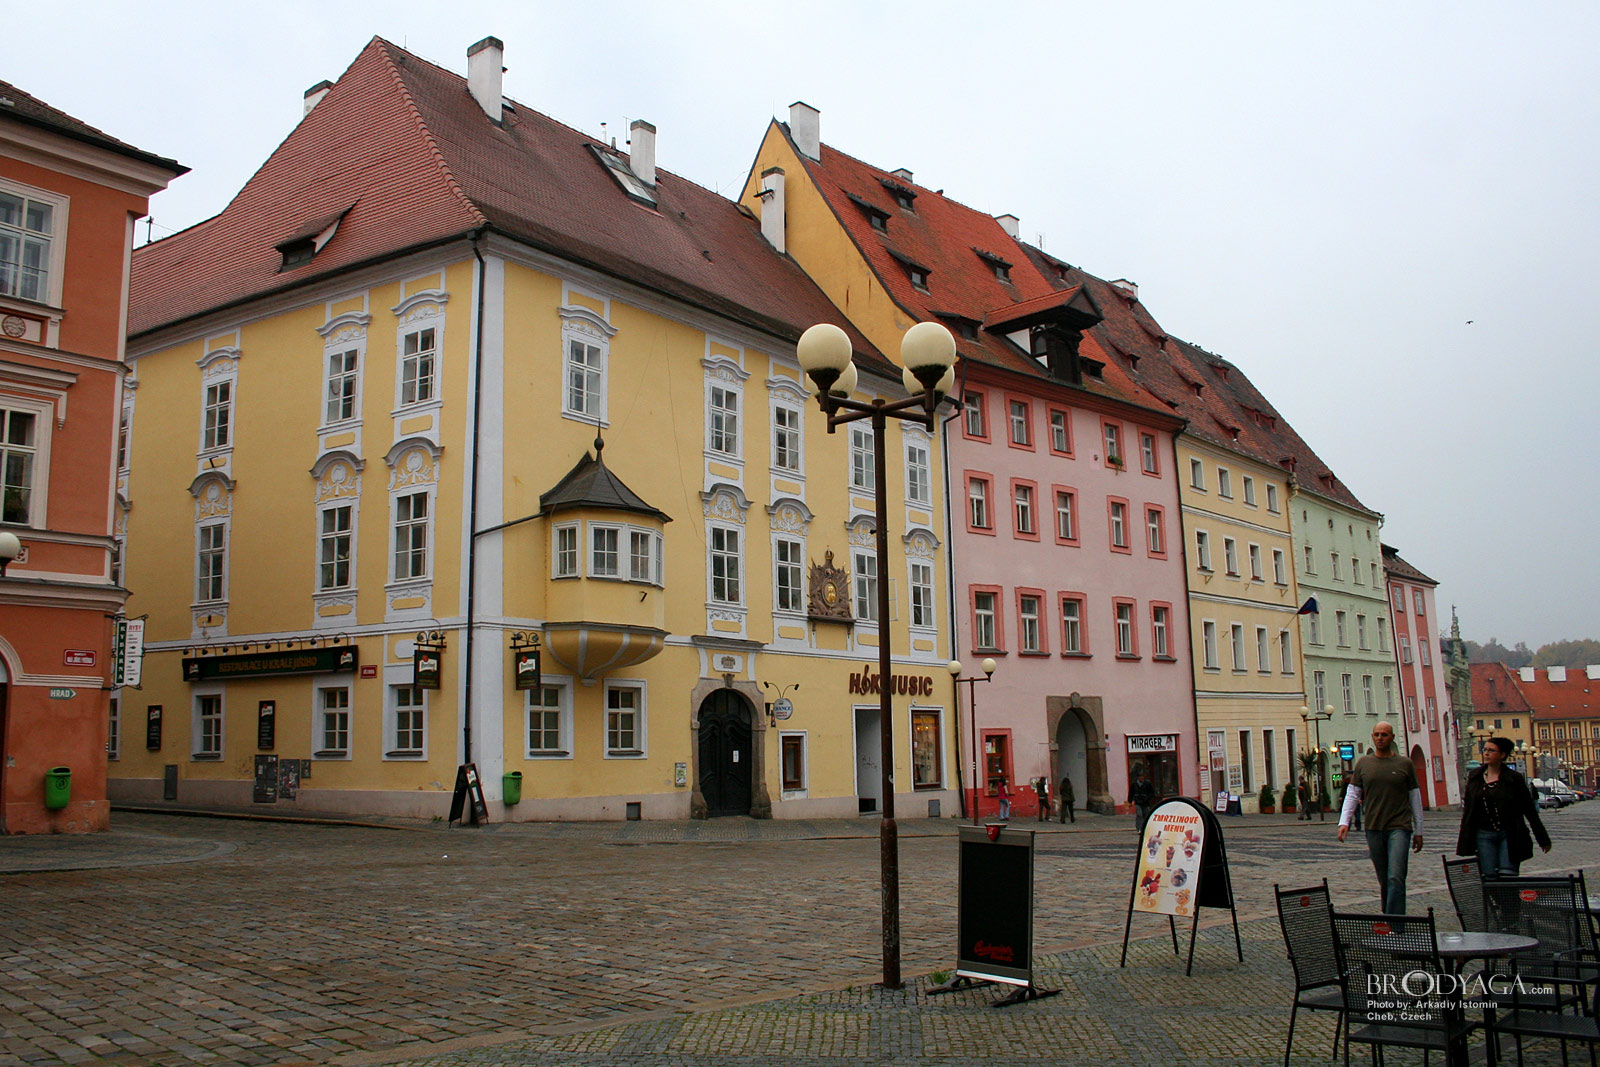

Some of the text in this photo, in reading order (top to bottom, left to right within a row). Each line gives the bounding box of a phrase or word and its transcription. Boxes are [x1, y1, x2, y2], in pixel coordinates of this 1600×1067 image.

[50, 689, 70, 698] HRAD
[1153, 814, 1199, 824] ZMRZLINOVÉ
[1163, 824, 1186, 833] MENU
